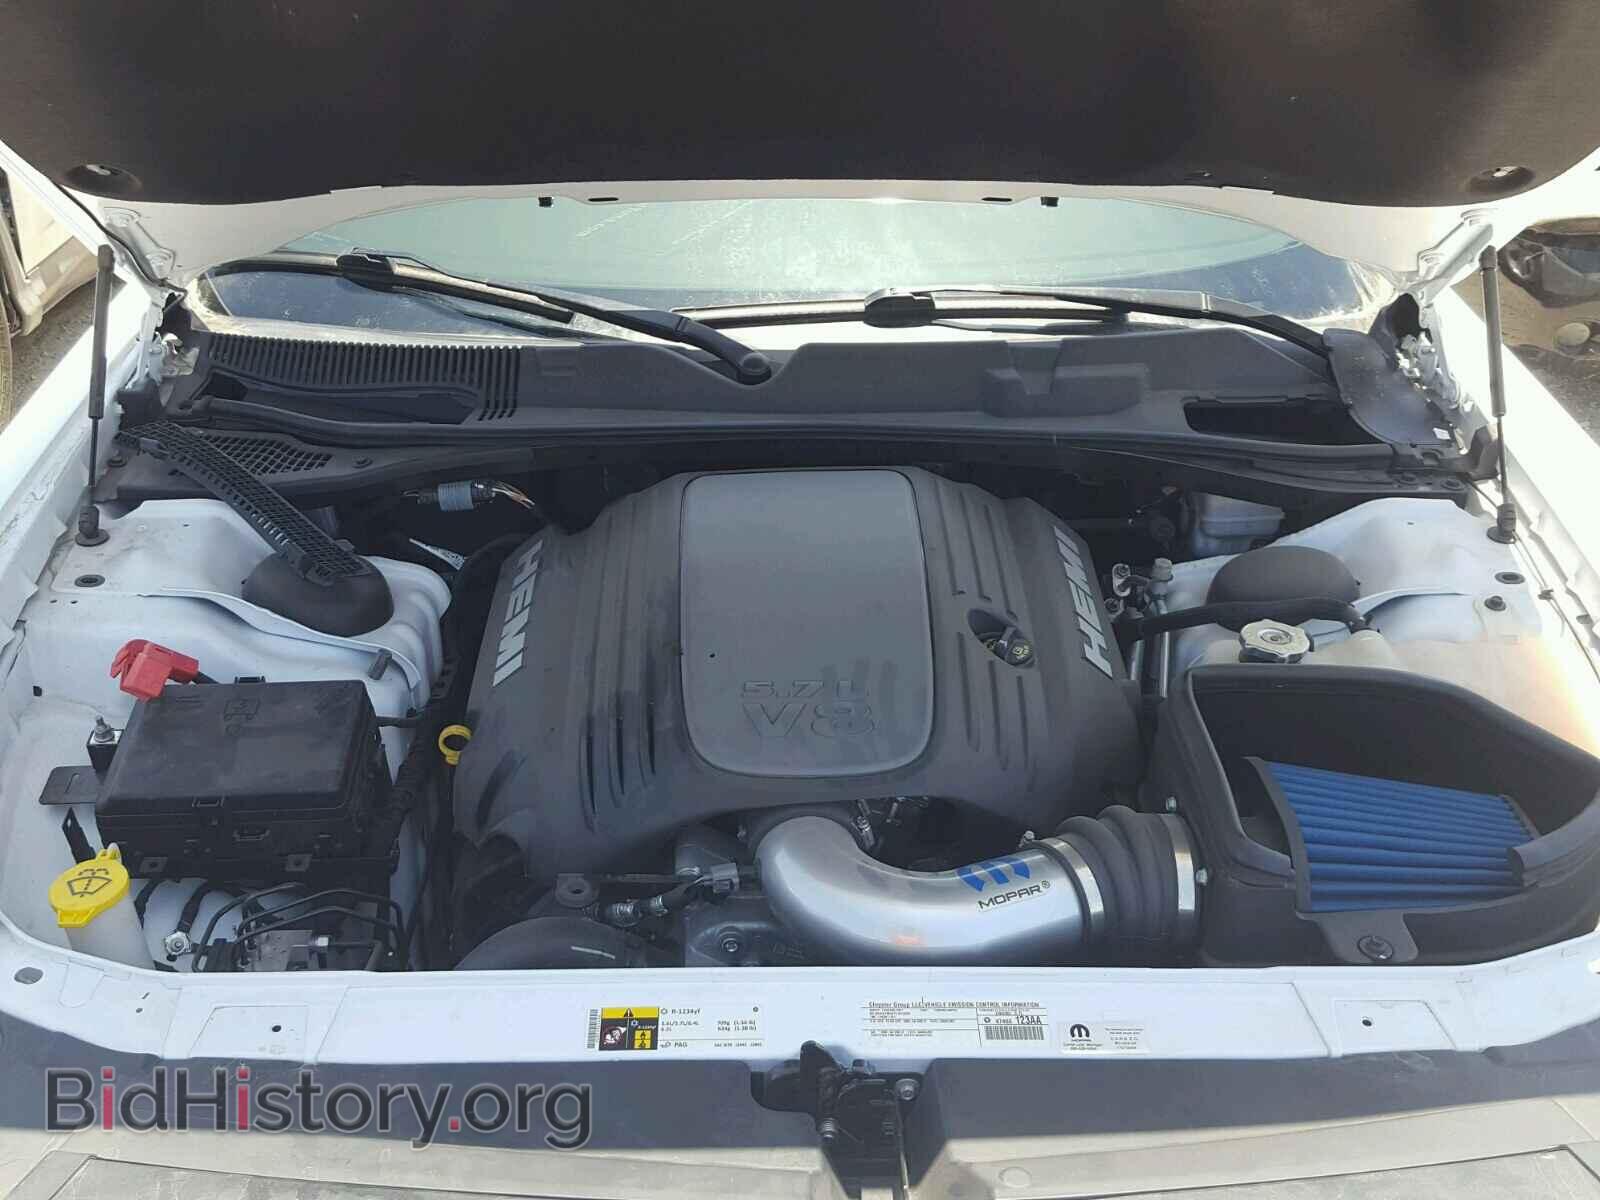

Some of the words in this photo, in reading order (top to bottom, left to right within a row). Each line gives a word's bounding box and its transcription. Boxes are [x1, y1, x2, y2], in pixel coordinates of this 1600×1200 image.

[492, 539, 544, 688] HEMI
[1053, 525, 1114, 680] HEMI
[741, 679, 871, 698] 5.7L
[742, 702, 876, 738] V8
[1016, 1015, 1043, 1025] 123AA
